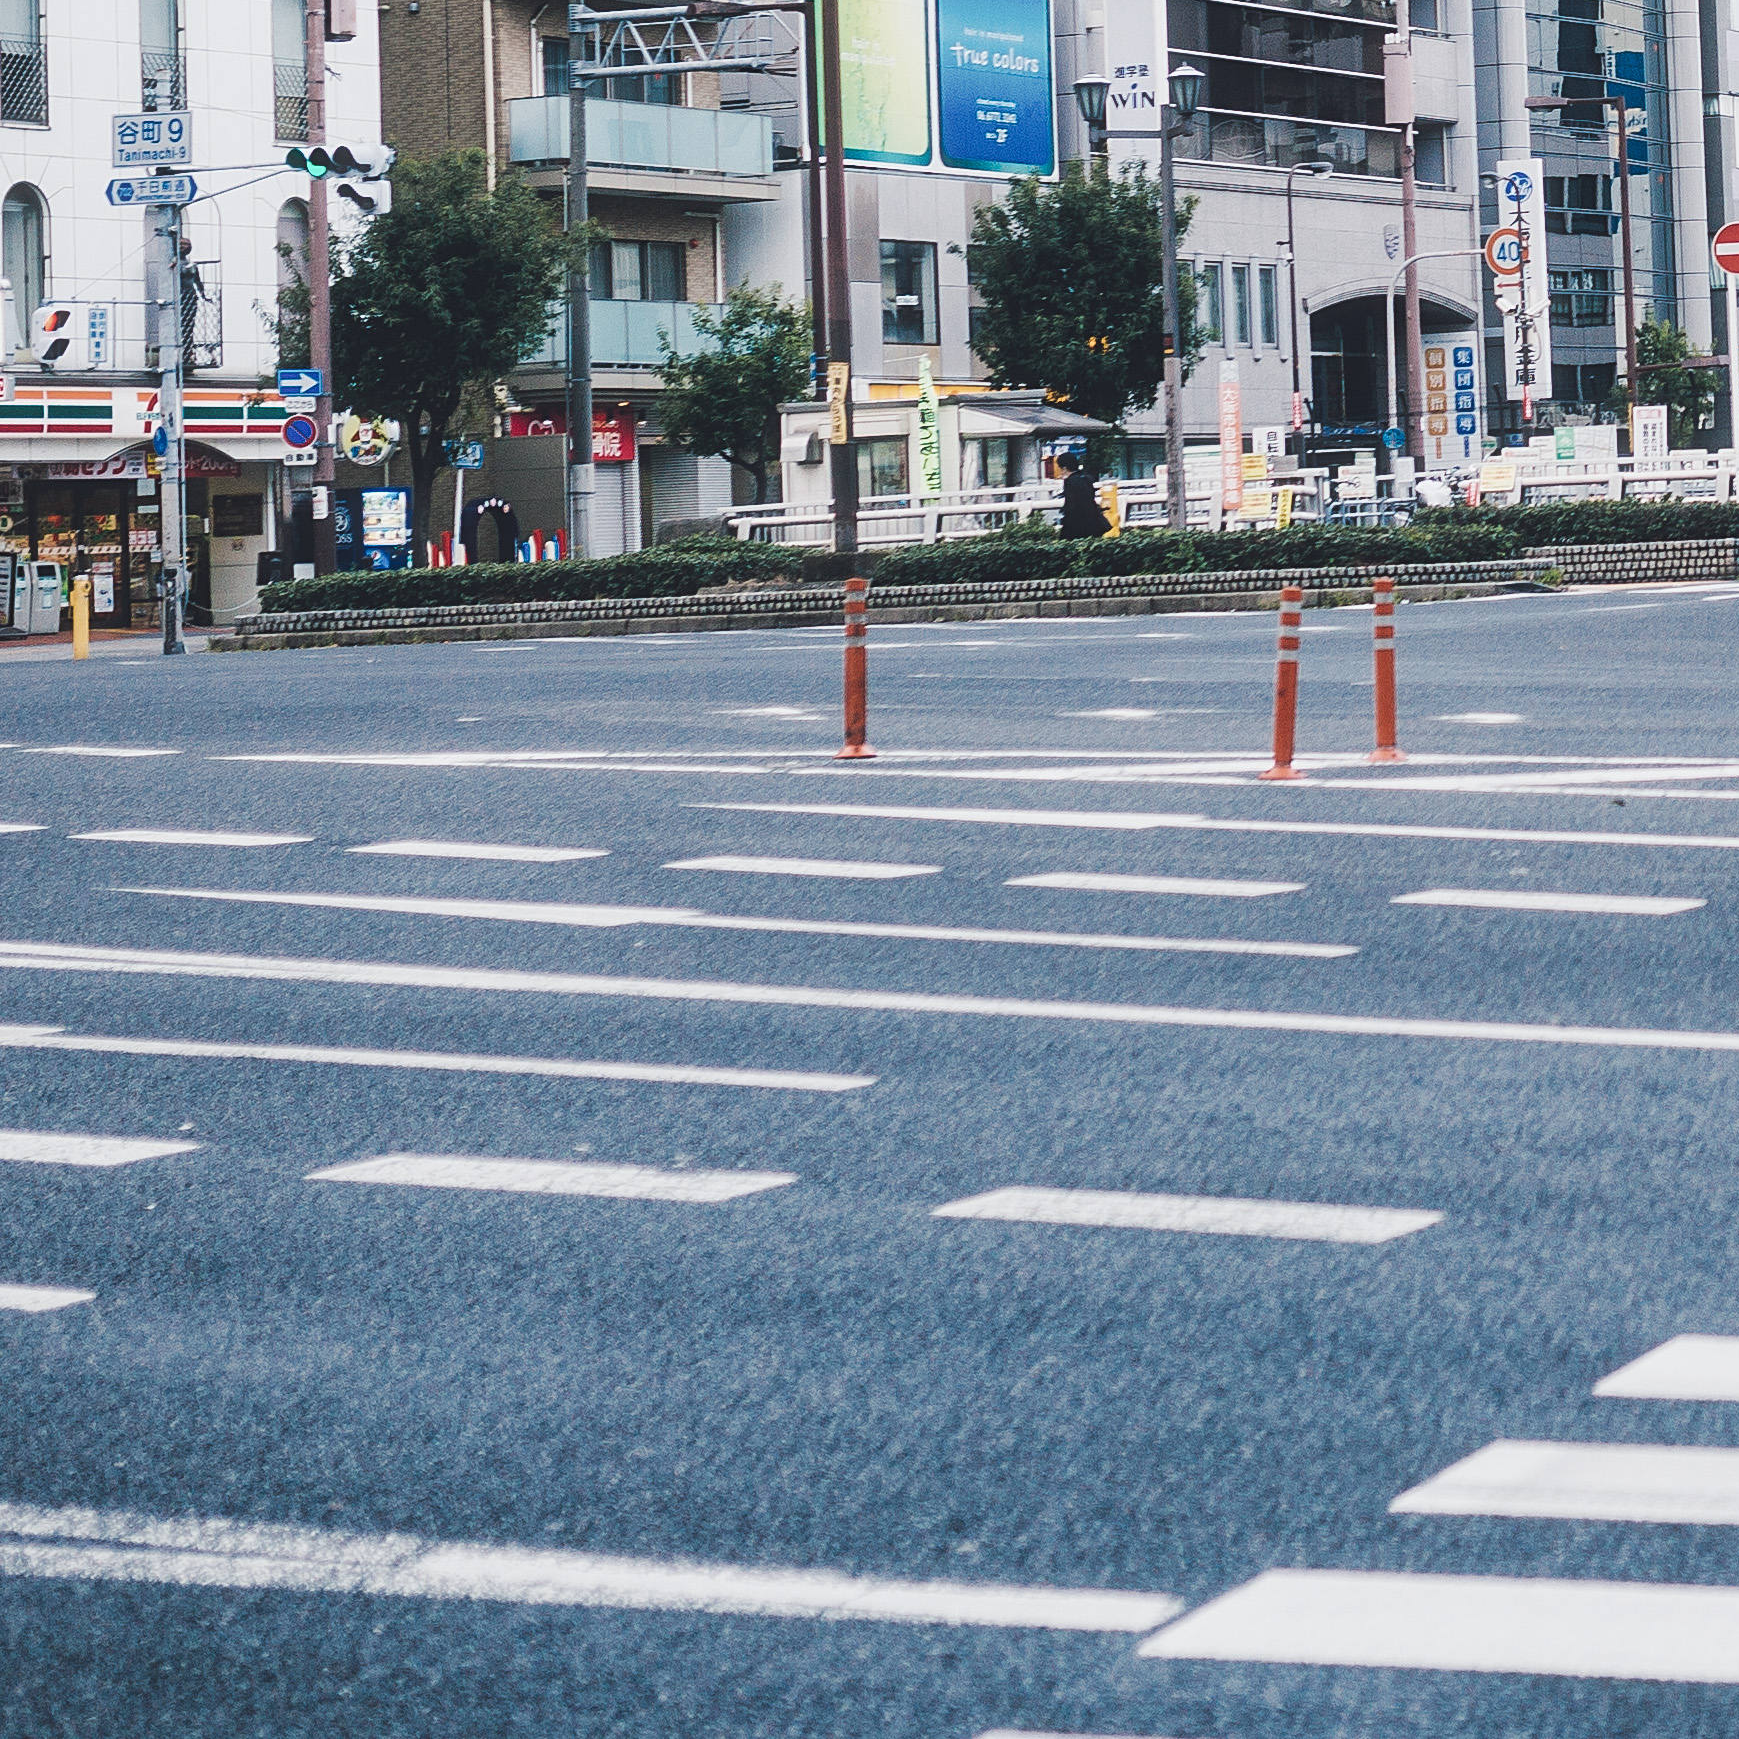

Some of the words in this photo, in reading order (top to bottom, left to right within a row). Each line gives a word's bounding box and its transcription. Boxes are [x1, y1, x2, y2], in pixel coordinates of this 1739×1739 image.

[949, 42, 988, 67] true
[993, 47, 1039, 73] colors
[118, 148, 187, 162] Tanimachi-9
[1496, 241, 1521, 262] 40
[1429, 352, 1445, 433] 個別指導
[1456, 350, 1473, 432] 集団指導
